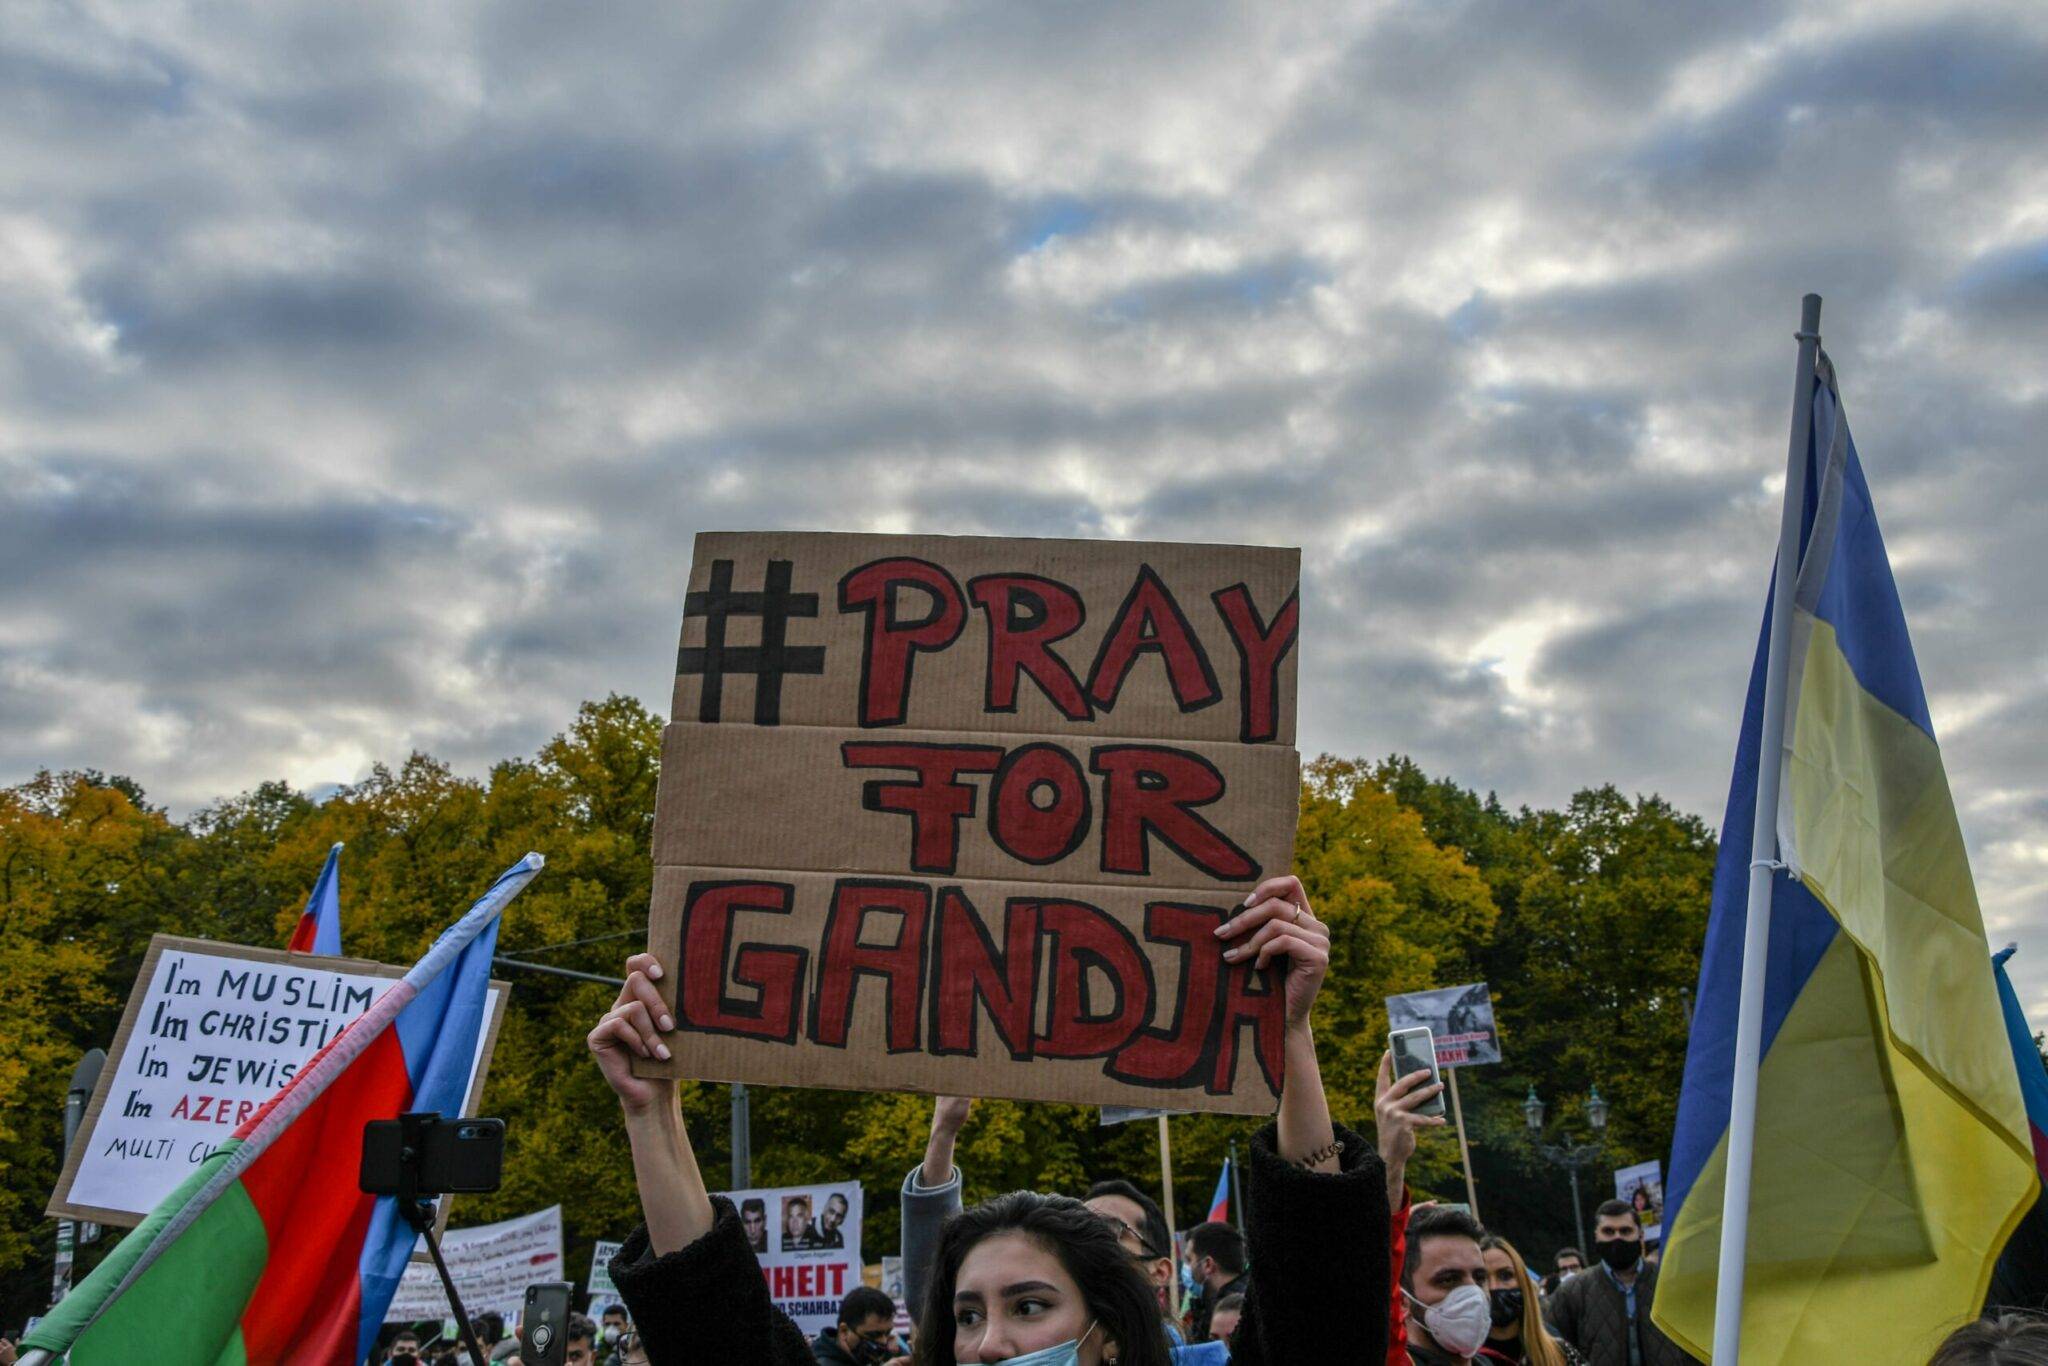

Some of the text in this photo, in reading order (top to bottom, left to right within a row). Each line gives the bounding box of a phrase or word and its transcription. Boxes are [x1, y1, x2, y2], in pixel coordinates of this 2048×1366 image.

[680, 557, 1299, 742] #PRAY
[843, 741, 1262, 881] FOR
[164, 958, 200, 996] I'm
[677, 878, 1286, 1095] GANDJA
[150, 1000, 188, 1041] I'm
[138, 1045, 168, 1078] I'm
[124, 1089, 267, 1126] I'm AZER
